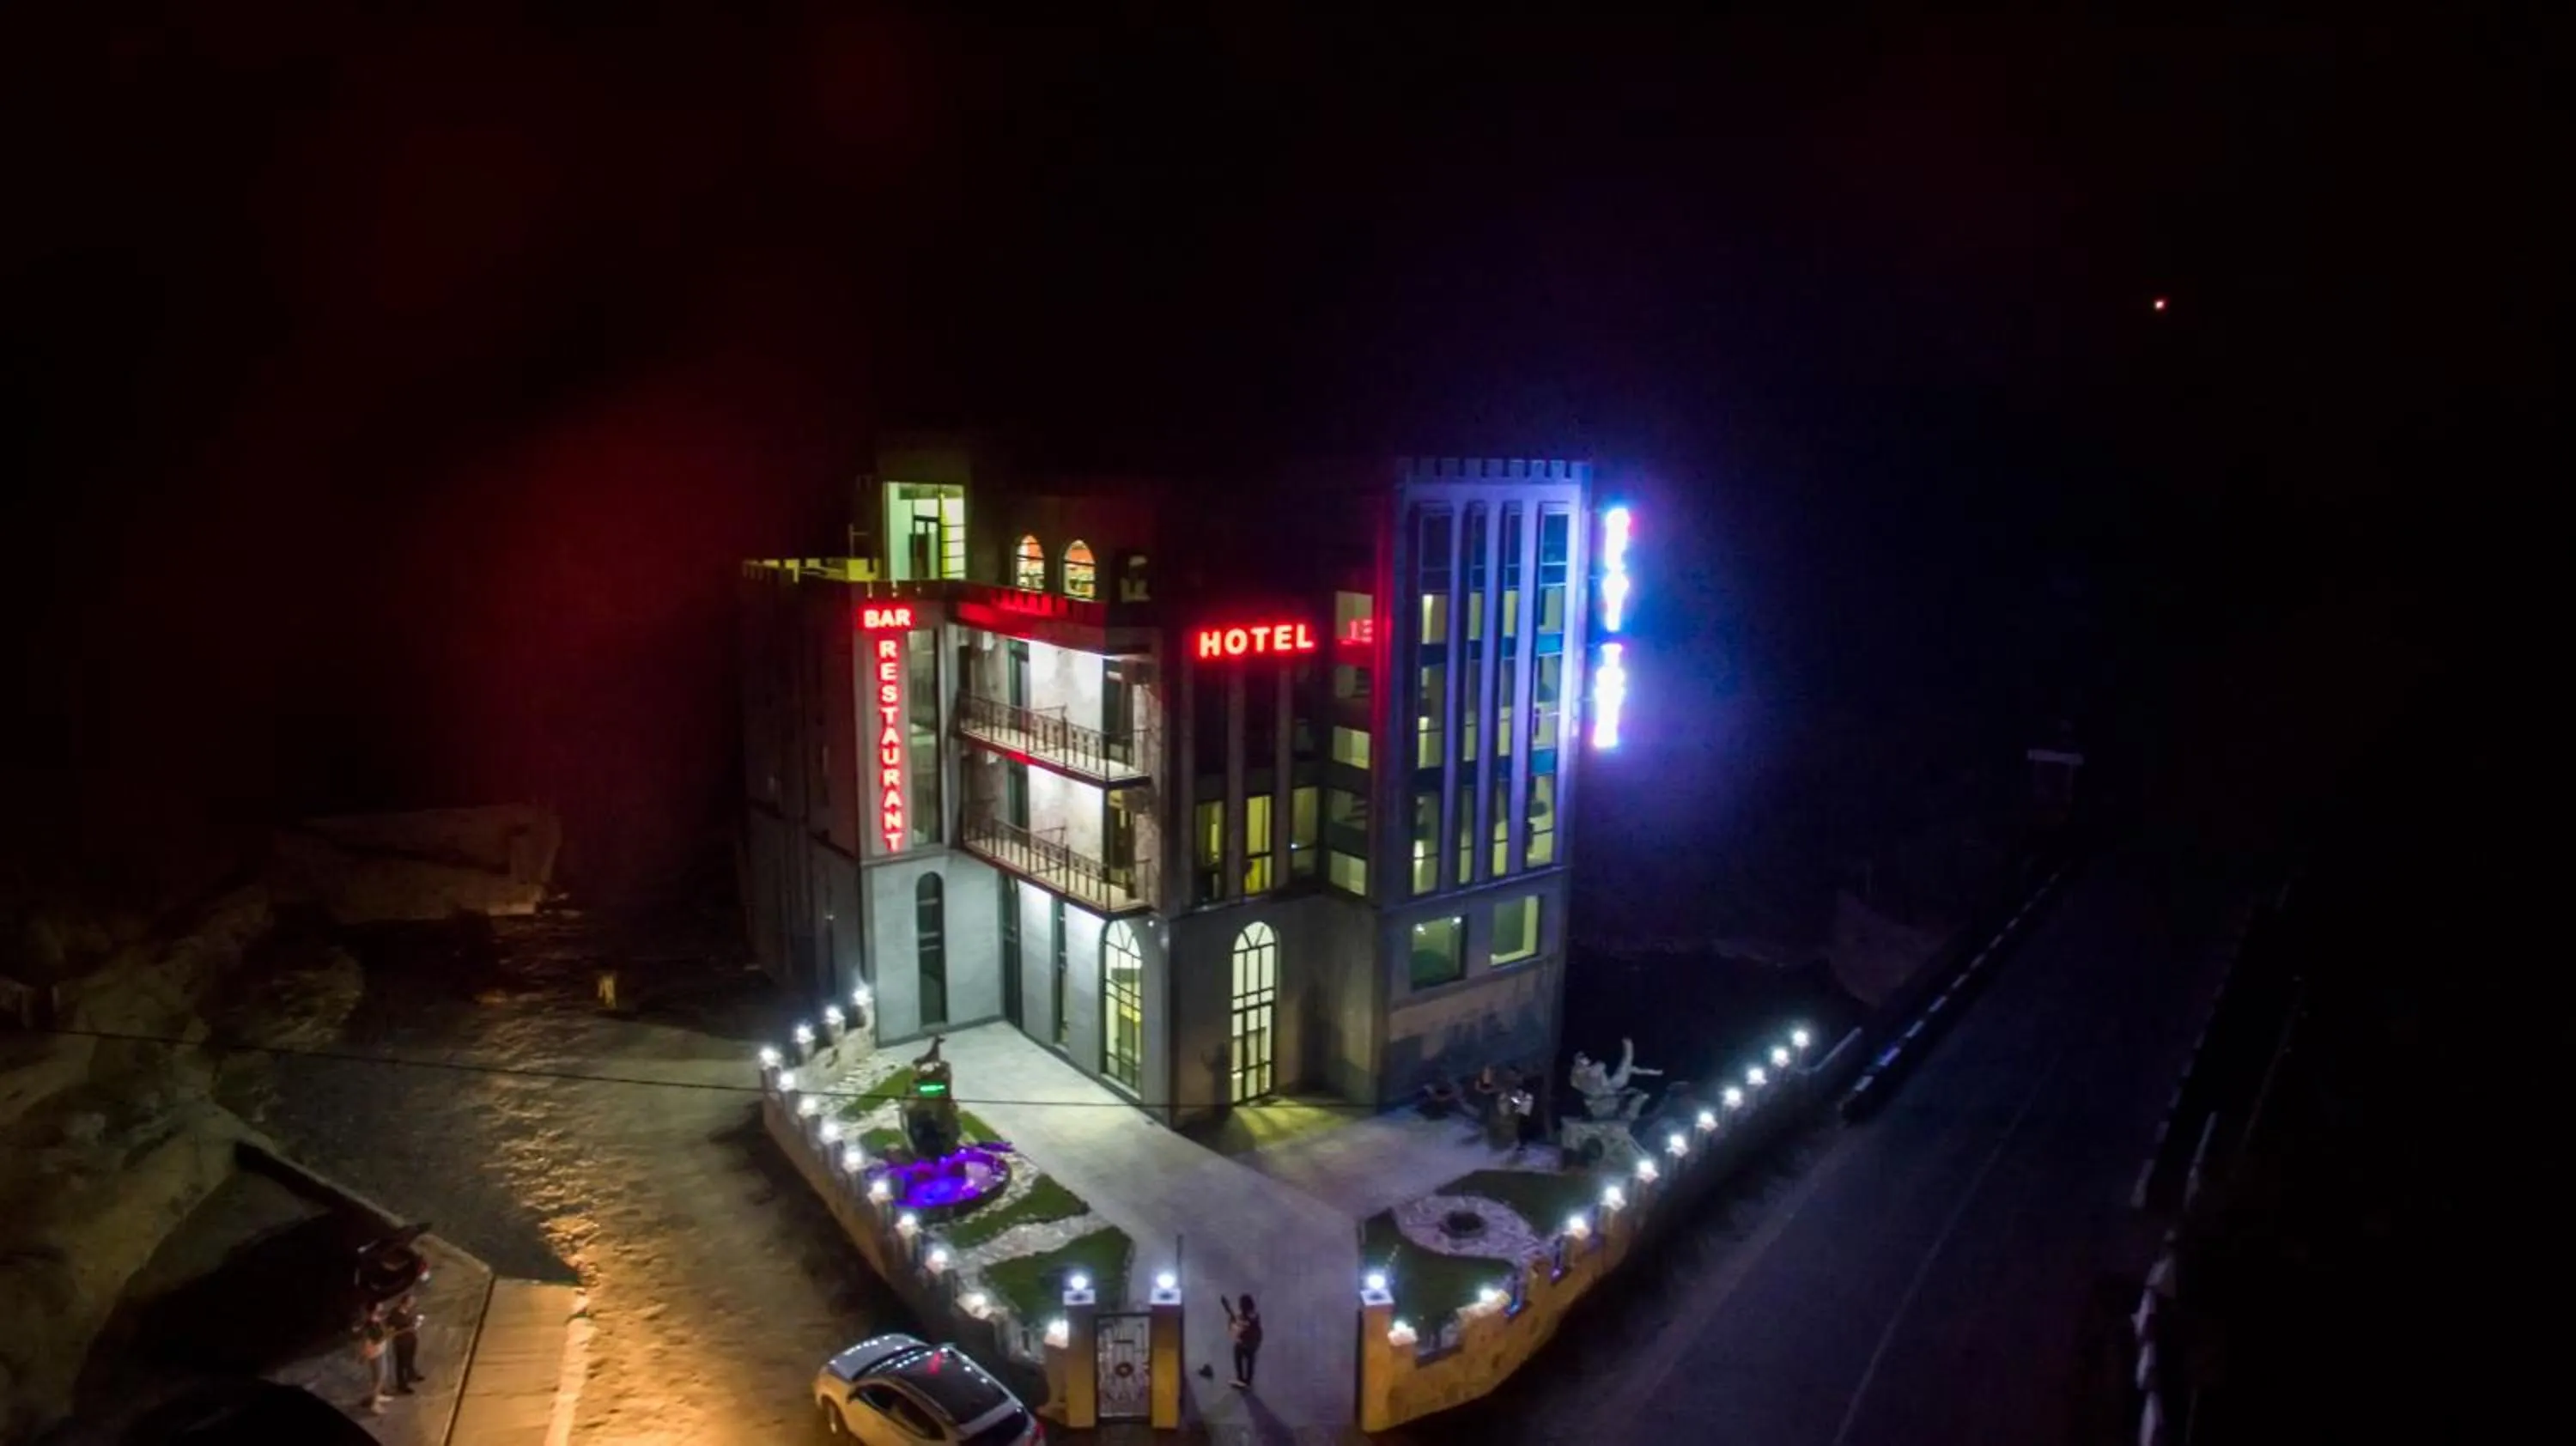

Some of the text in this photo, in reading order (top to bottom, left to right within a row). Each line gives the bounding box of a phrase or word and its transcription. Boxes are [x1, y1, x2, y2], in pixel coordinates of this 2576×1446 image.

[864, 609, 911, 628] BAR
[1199, 623, 1315, 658] HOTEL
[878, 640, 904, 852] RESTAURANT
